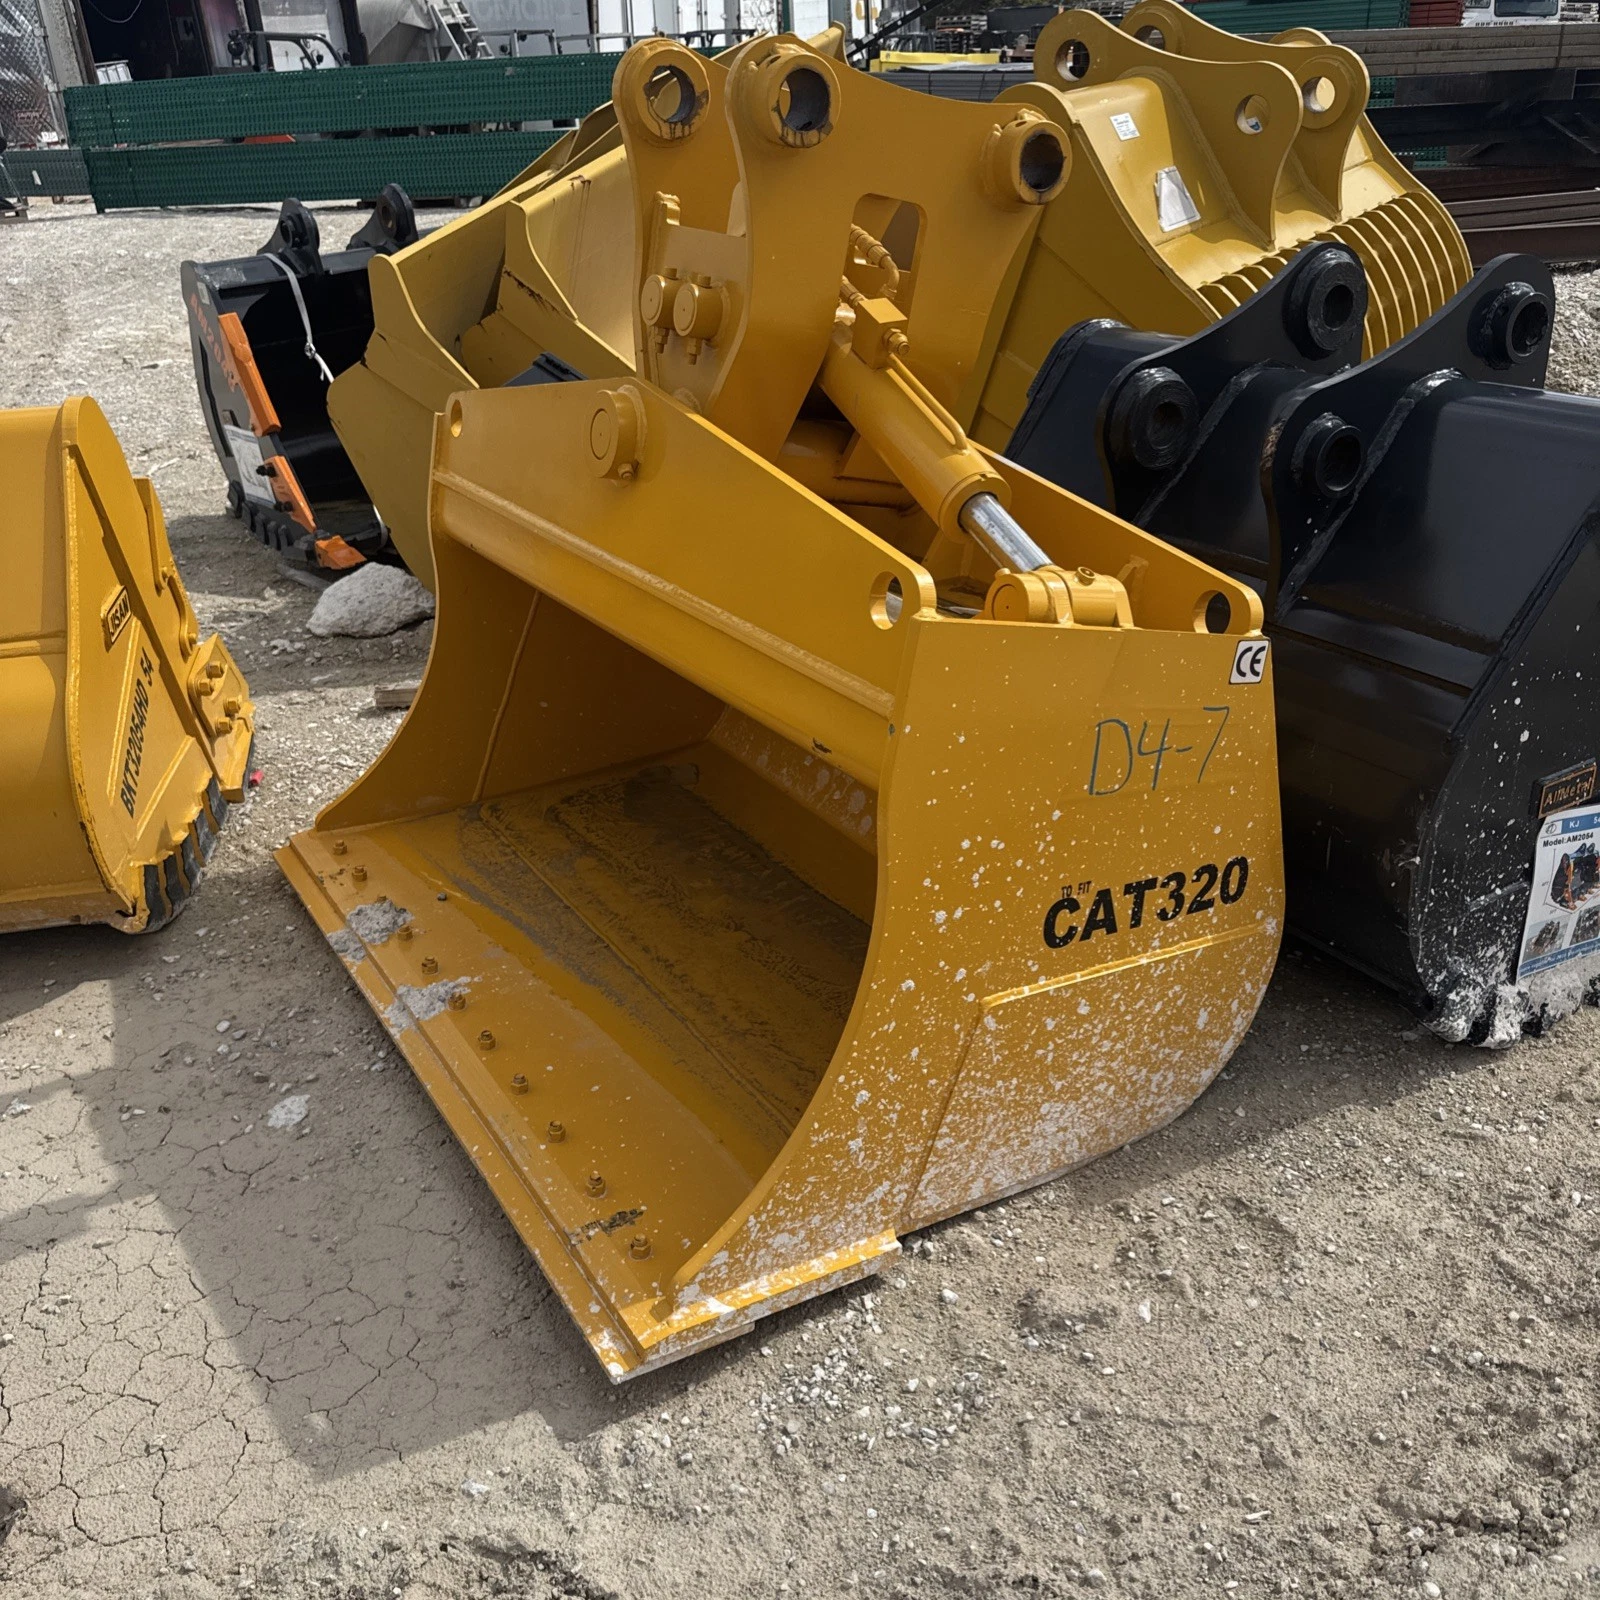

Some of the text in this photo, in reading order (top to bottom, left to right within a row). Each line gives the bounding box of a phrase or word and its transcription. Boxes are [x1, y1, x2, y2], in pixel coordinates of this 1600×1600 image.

[141, 647, 154, 687] 54
[1236, 646, 1266, 677] CE
[1088, 706, 1230, 796] D4-7
[1570, 820, 1580, 828] KJ
[1543, 832, 1594, 848] Model:AM2054
[1043, 856, 1250, 949] CAT320
[1061, 885, 1072, 898] TO
